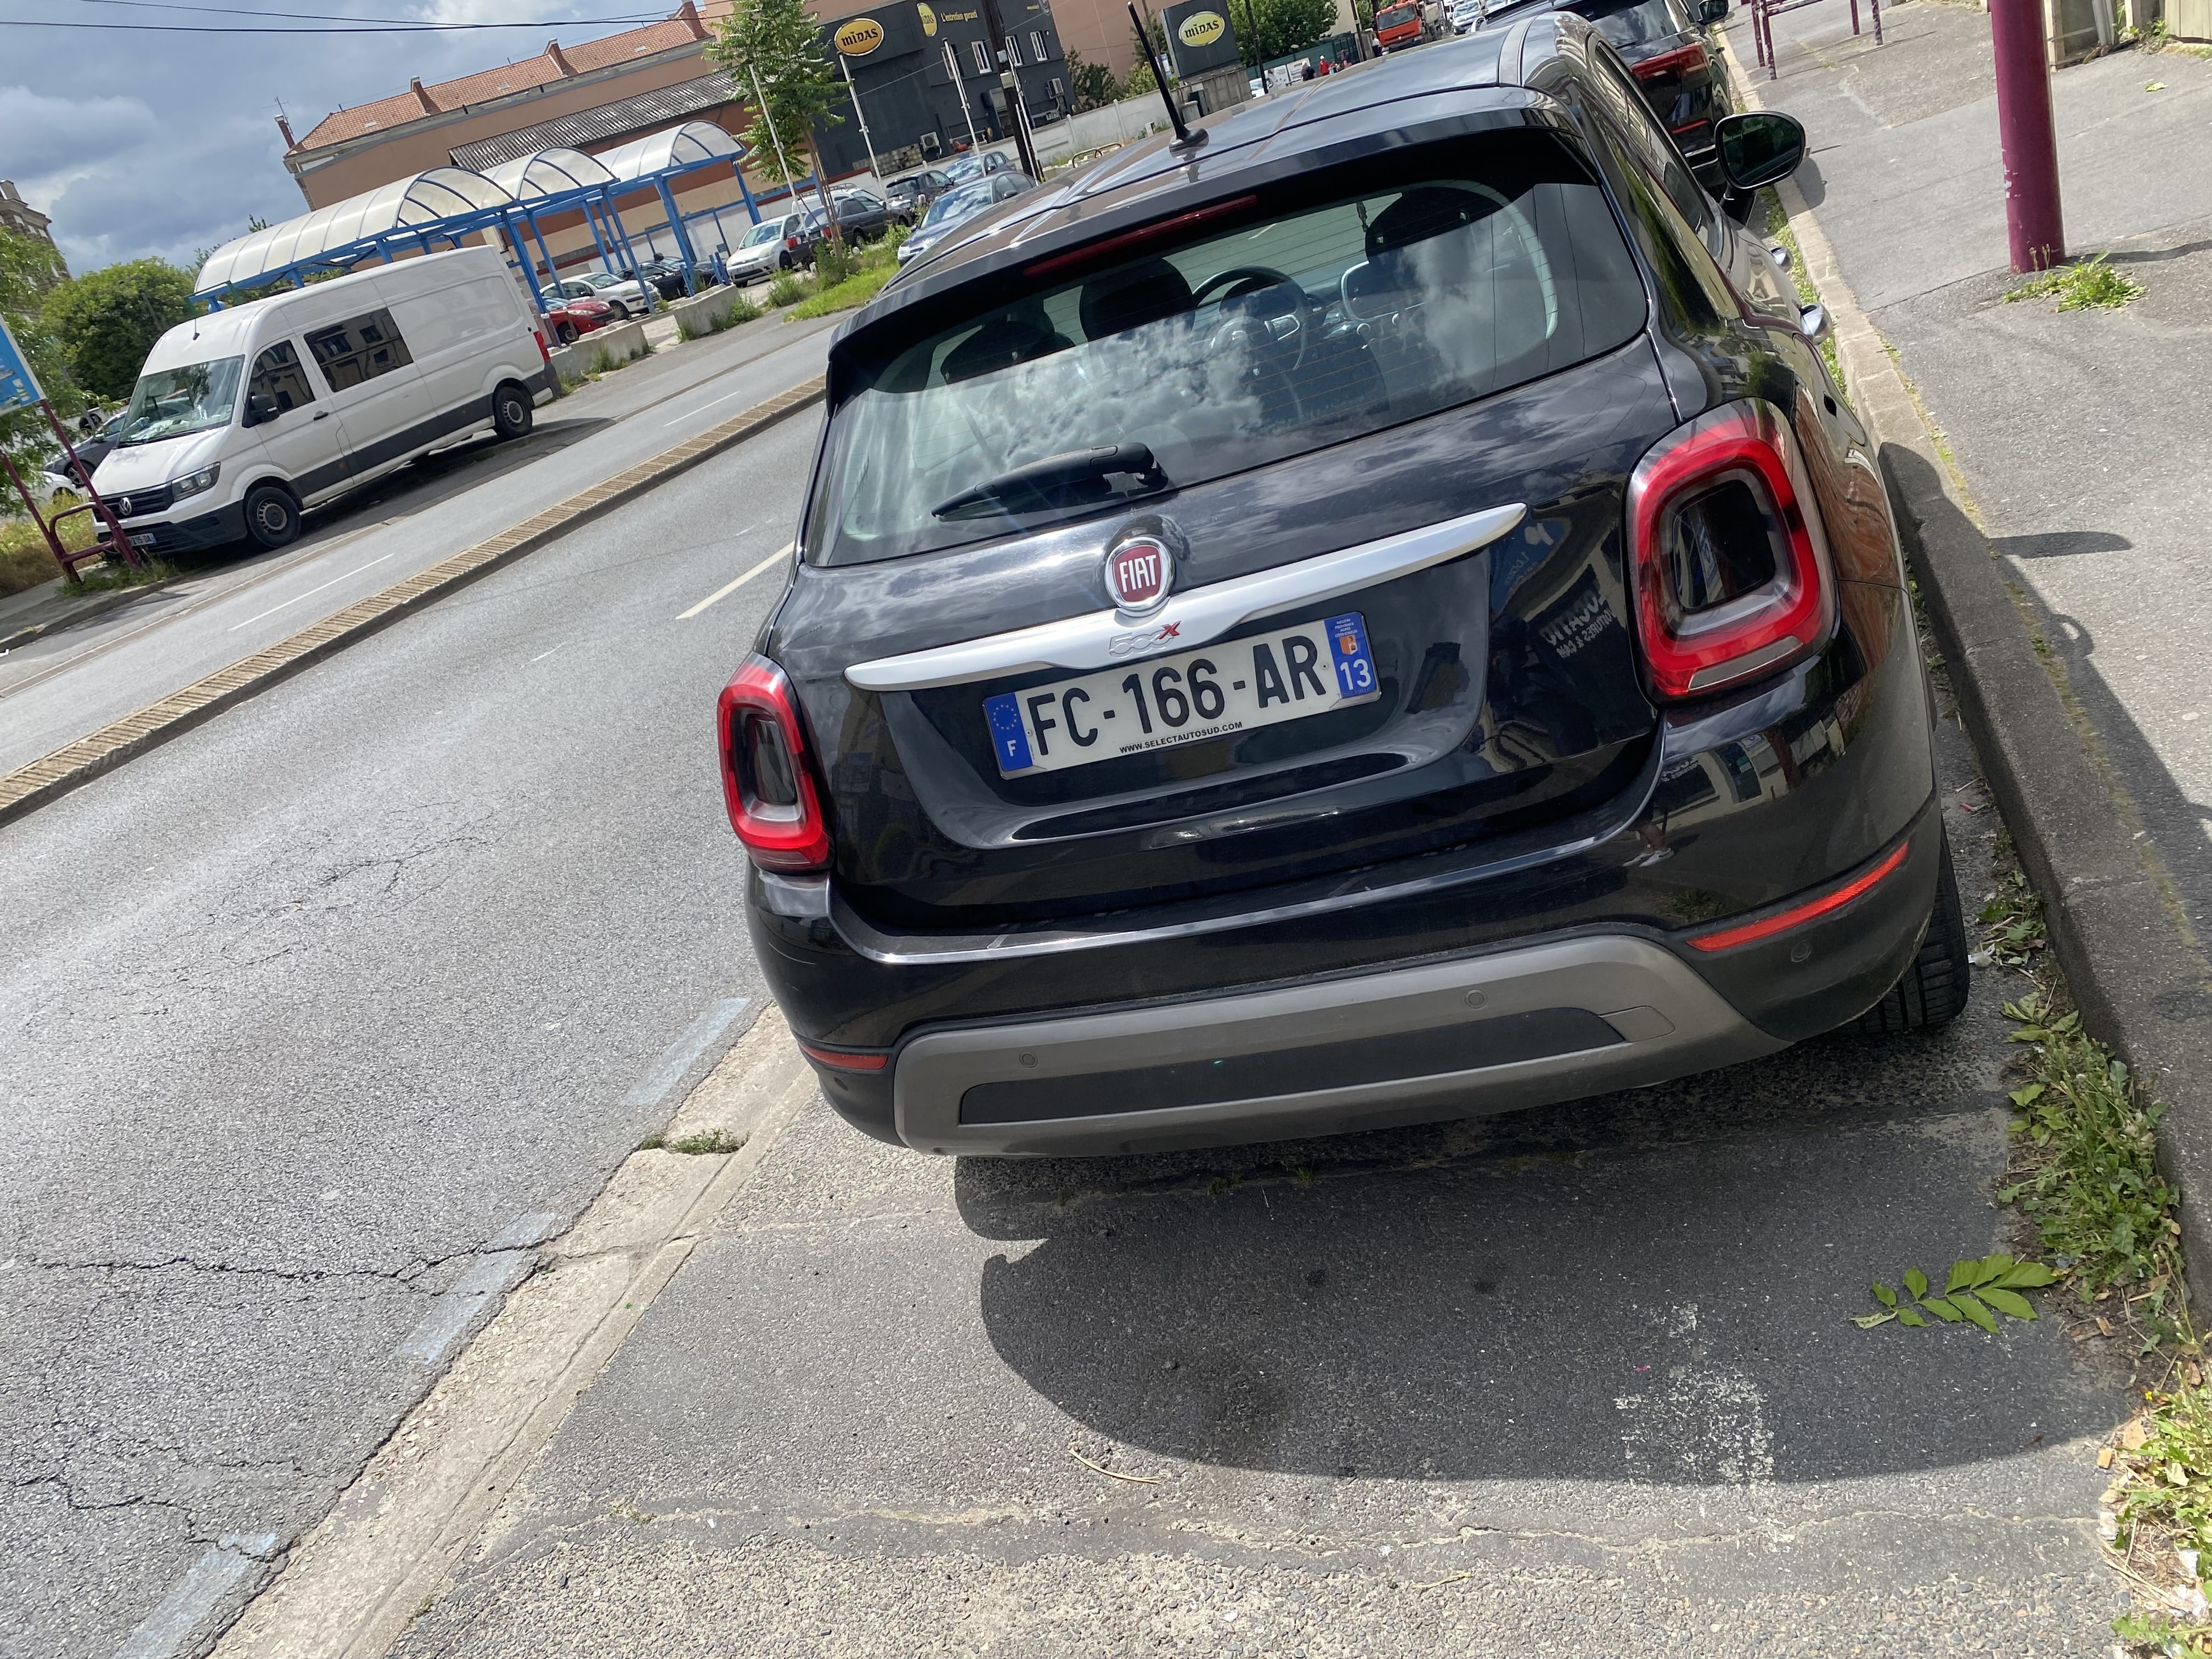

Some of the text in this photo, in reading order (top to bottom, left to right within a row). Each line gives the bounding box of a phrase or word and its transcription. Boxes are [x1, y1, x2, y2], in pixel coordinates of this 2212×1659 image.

[1119, 555, 1156, 592] FIAT
[1340, 658, 1372, 690] 13
[1027, 635, 1327, 757] FC-166-AR
[1007, 739, 1017, 758] F
[1119, 721, 1243, 754] WWW.SELECTAUTOSUD.COM
